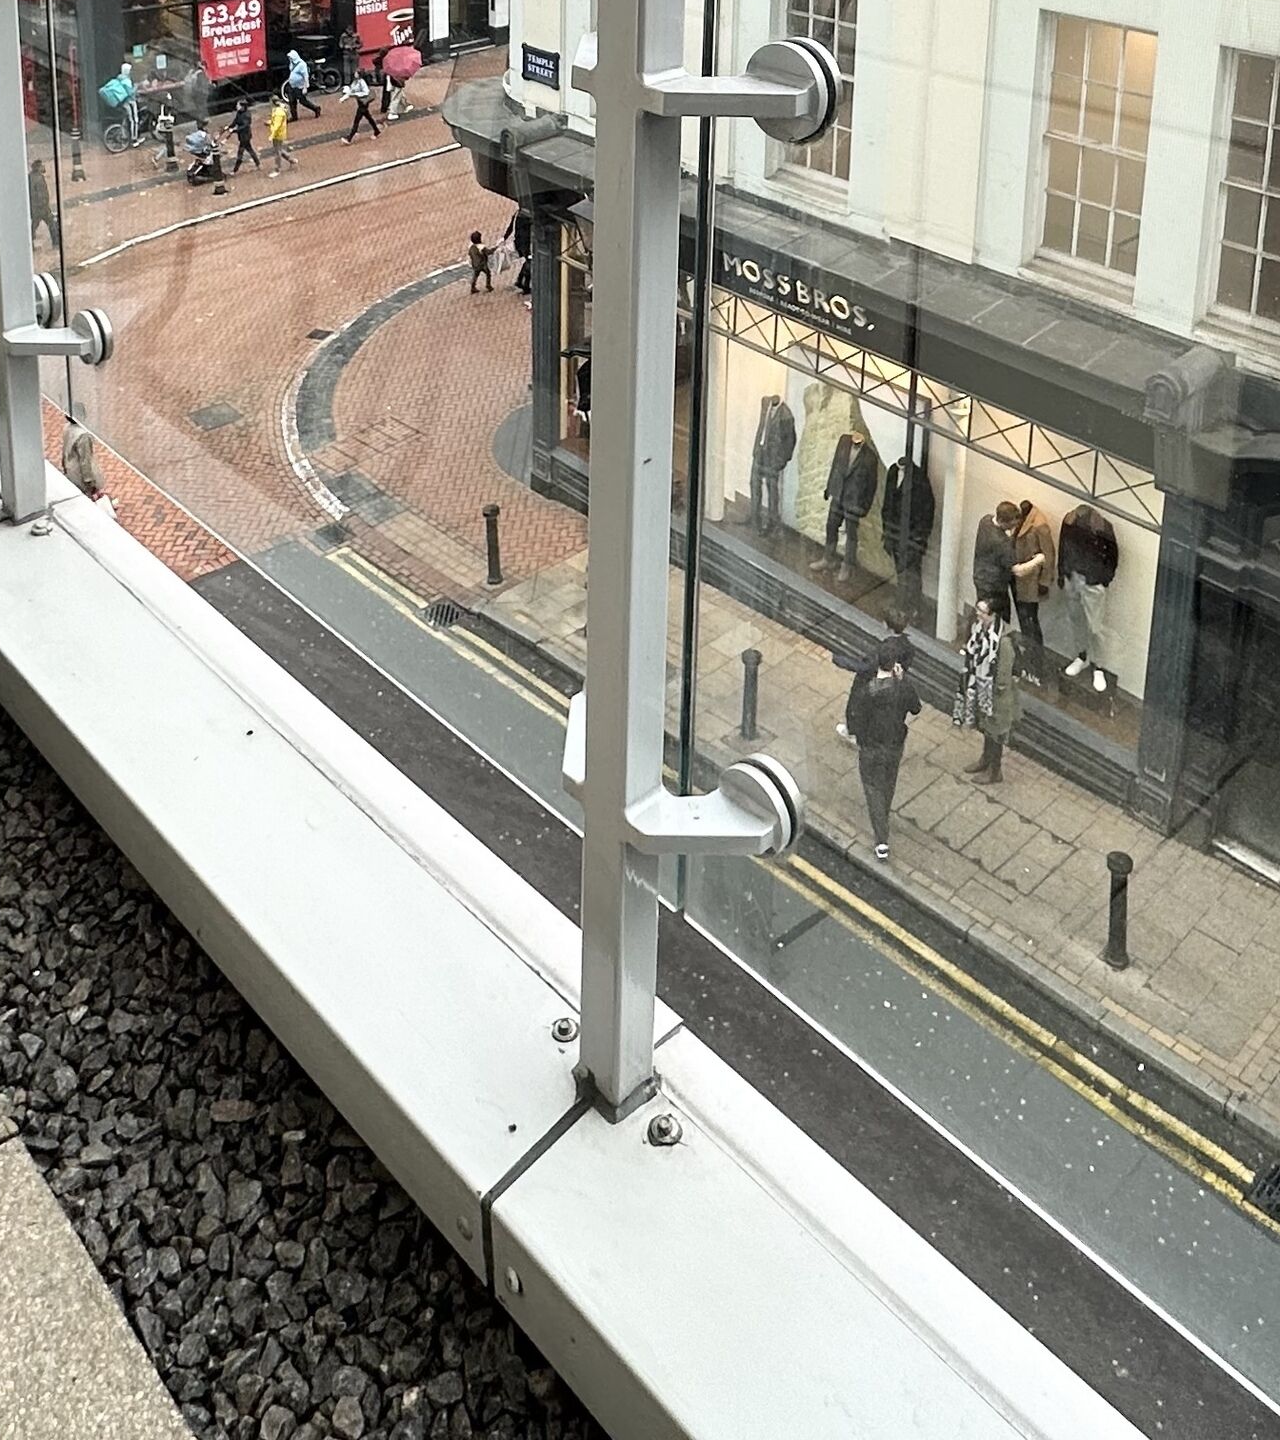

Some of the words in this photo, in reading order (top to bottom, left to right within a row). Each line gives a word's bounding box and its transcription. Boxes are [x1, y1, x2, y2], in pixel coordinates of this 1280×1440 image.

[202, 0, 262, 26] £3.49
[356, 2, 388, 16] INSIDE
[201, 17, 262, 38] Breakfast
[213, 32, 252, 49] Meals
[527, 53, 555, 69] TEMPLE
[527, 63, 554, 79] STREET
[722, 251, 791, 296] MOSS
